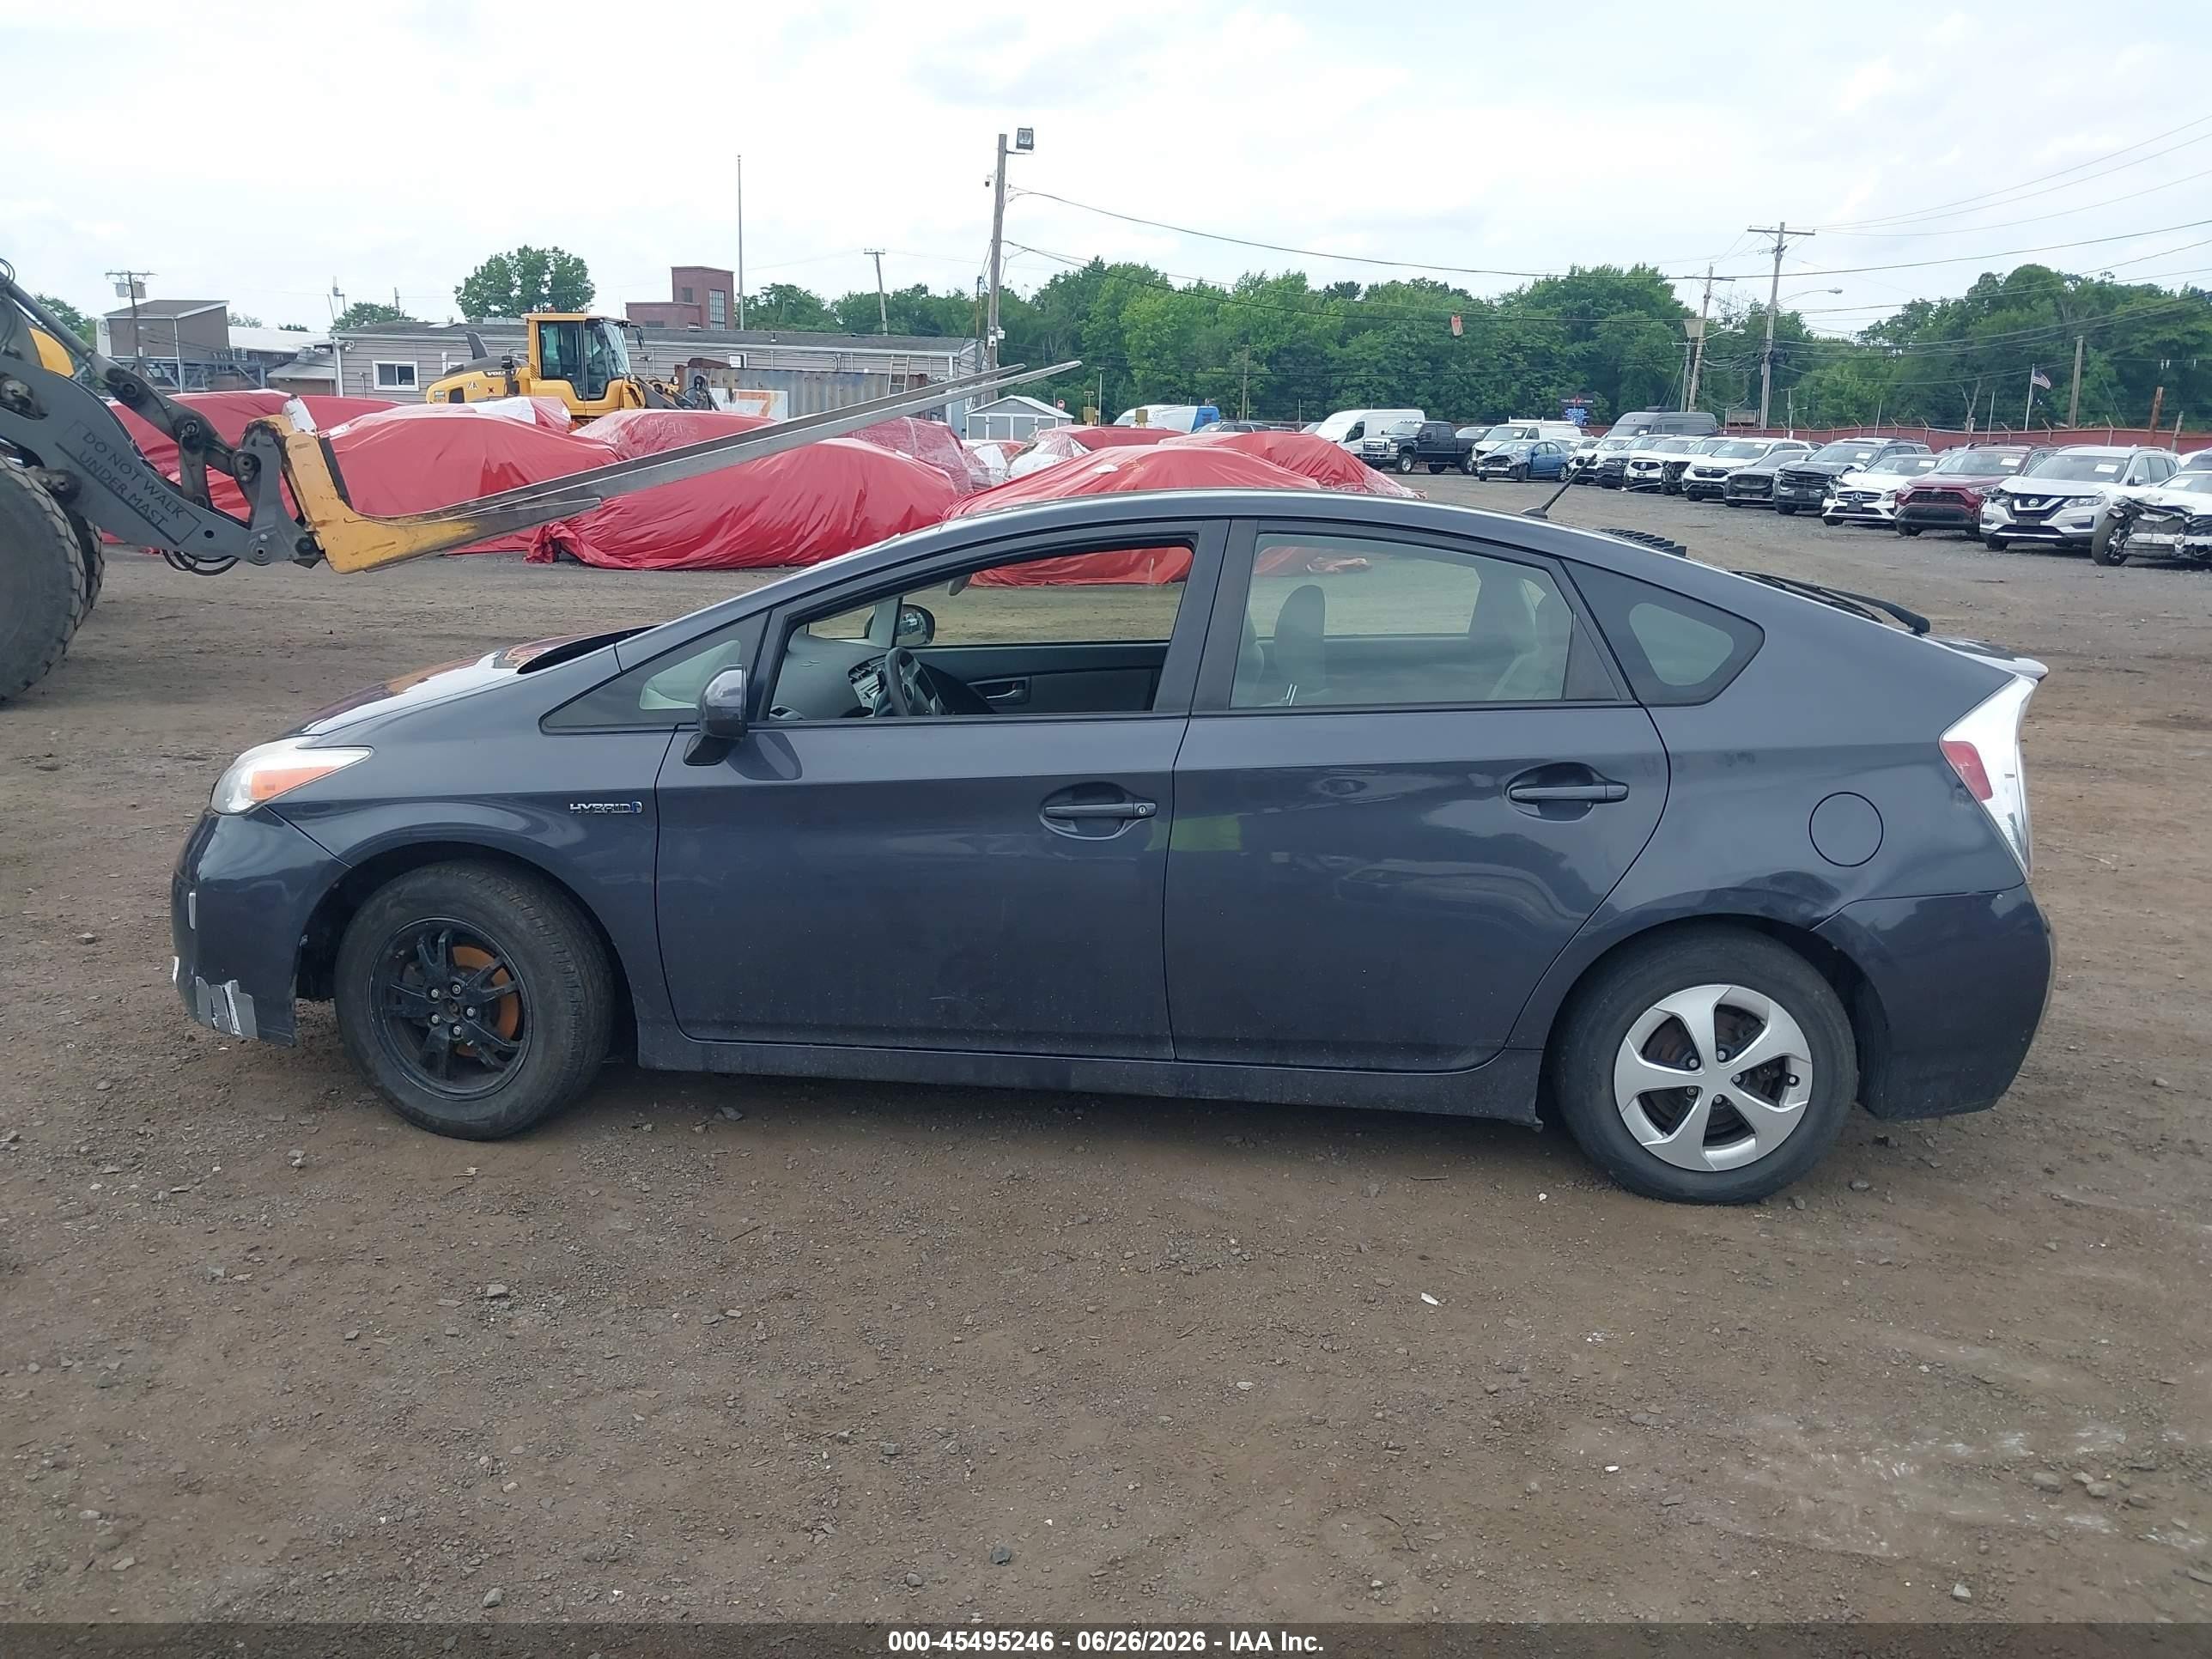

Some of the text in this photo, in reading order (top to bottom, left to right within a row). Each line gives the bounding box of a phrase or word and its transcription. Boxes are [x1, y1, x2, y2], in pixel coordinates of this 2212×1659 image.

[79, 451, 168, 526] UNDER MAST
[82, 432, 185, 520] DO NOT WALK
[569, 803, 632, 814] HYBRID
